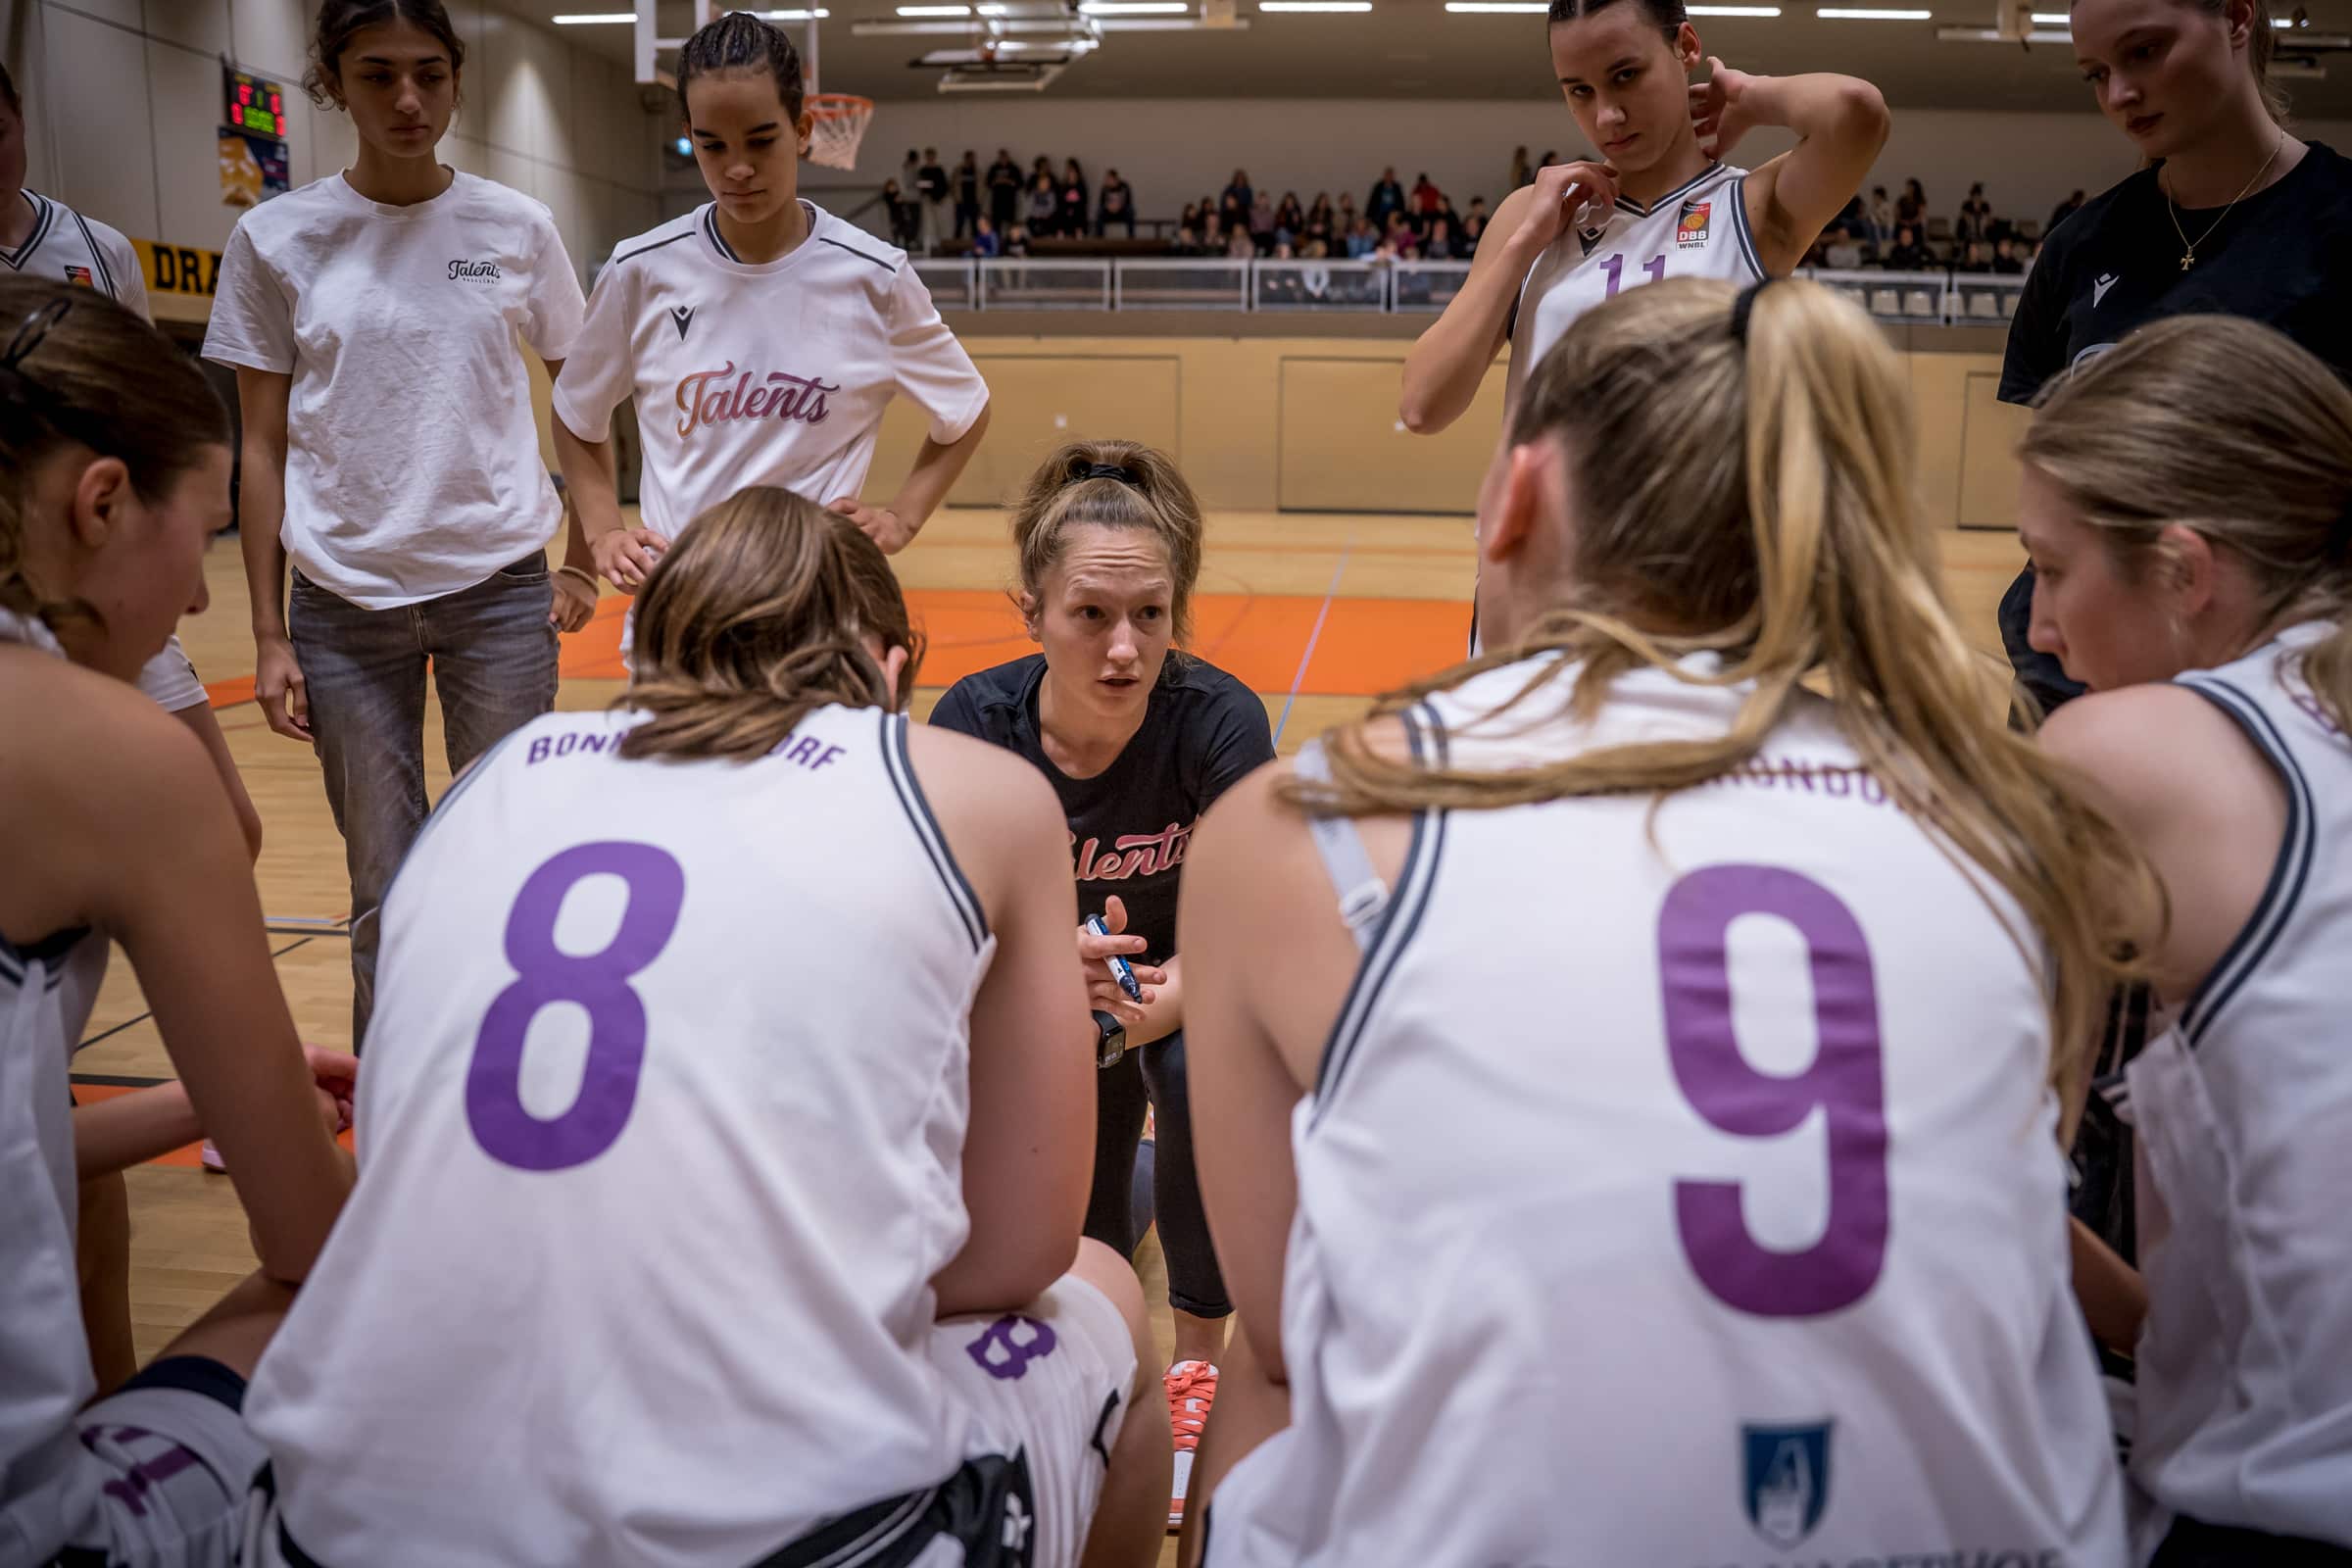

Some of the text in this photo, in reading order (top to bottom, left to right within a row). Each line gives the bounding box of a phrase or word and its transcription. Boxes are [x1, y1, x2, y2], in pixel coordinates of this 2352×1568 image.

[448, 259, 501, 280] Talents
[1679, 230, 1707, 241] DBB
[675, 360, 840, 438] Talents
[465, 840, 685, 1172] 8
[1657, 862, 1890, 1318] 9
